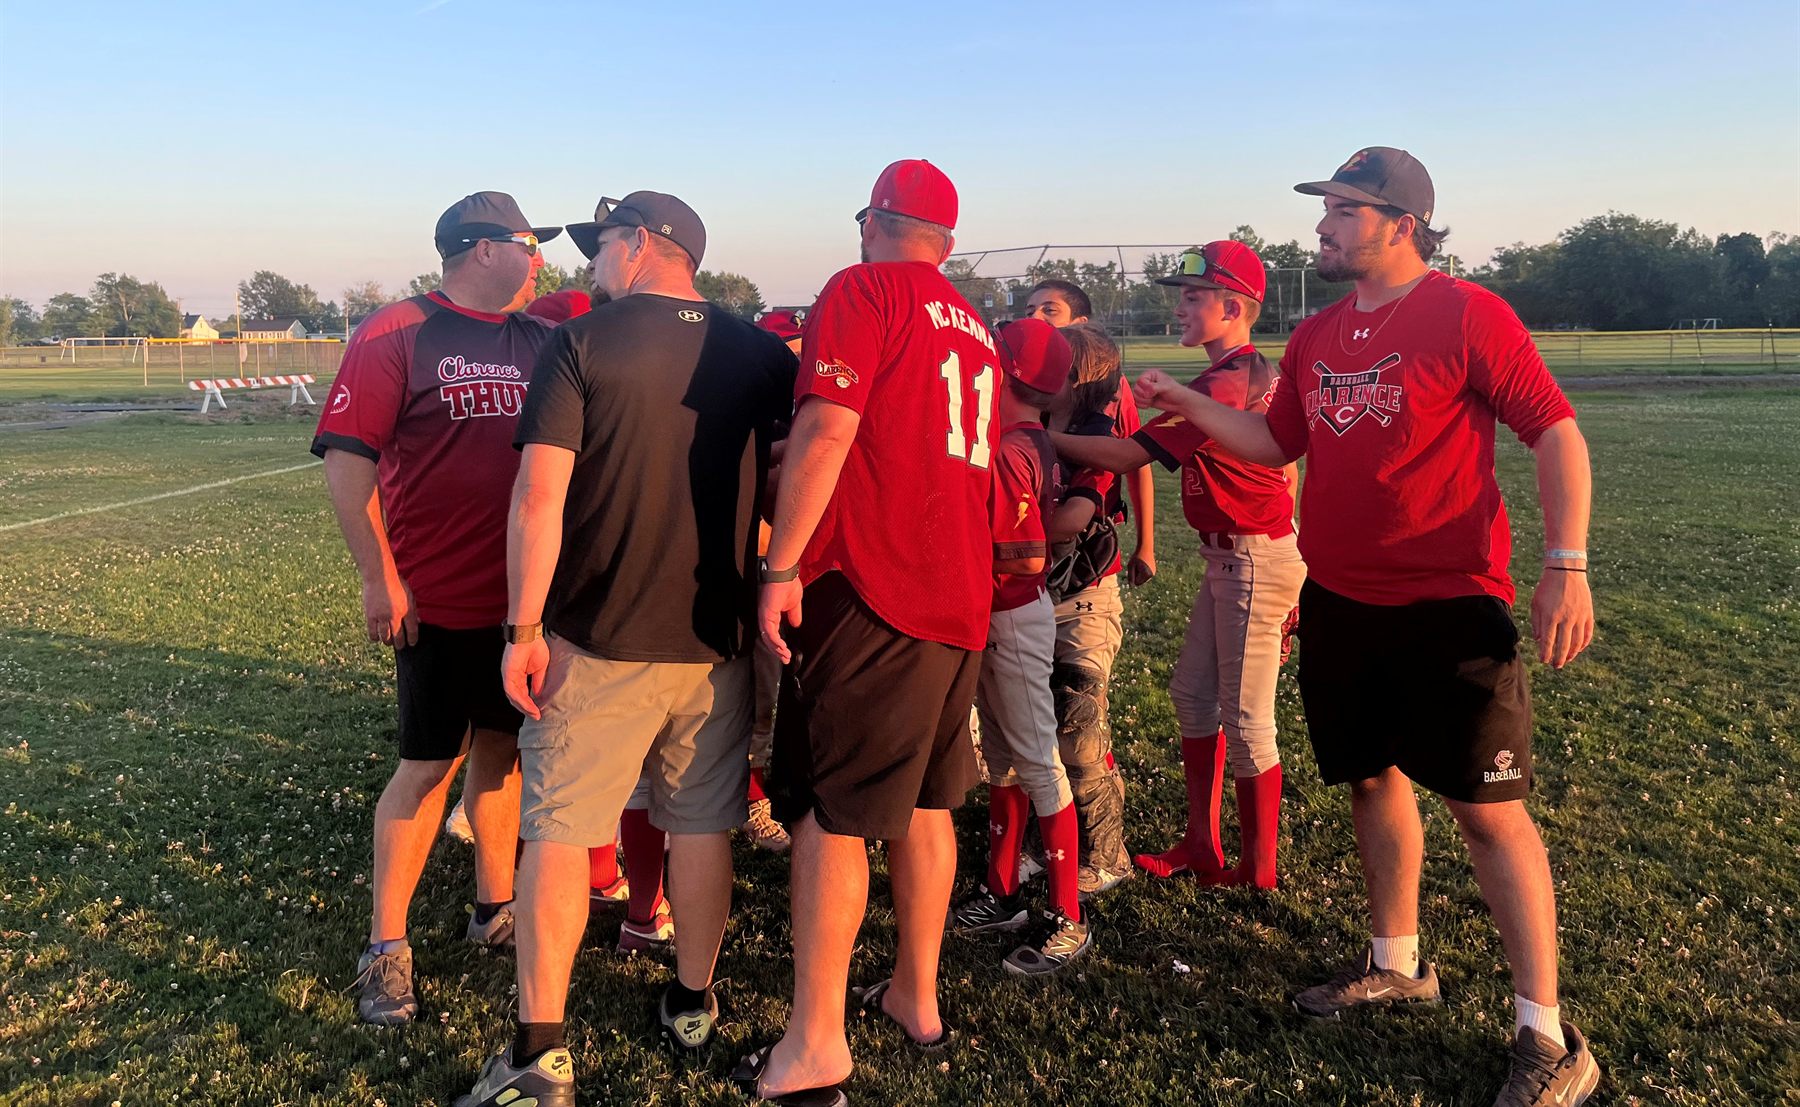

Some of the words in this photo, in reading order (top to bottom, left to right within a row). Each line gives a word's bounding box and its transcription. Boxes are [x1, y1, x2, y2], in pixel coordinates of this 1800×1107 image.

[438, 355, 521, 382] Clarence
[939, 350, 994, 471] 11
[1306, 383, 1402, 416] CLARENCE
[1484, 767, 1522, 783] BASEBALL
